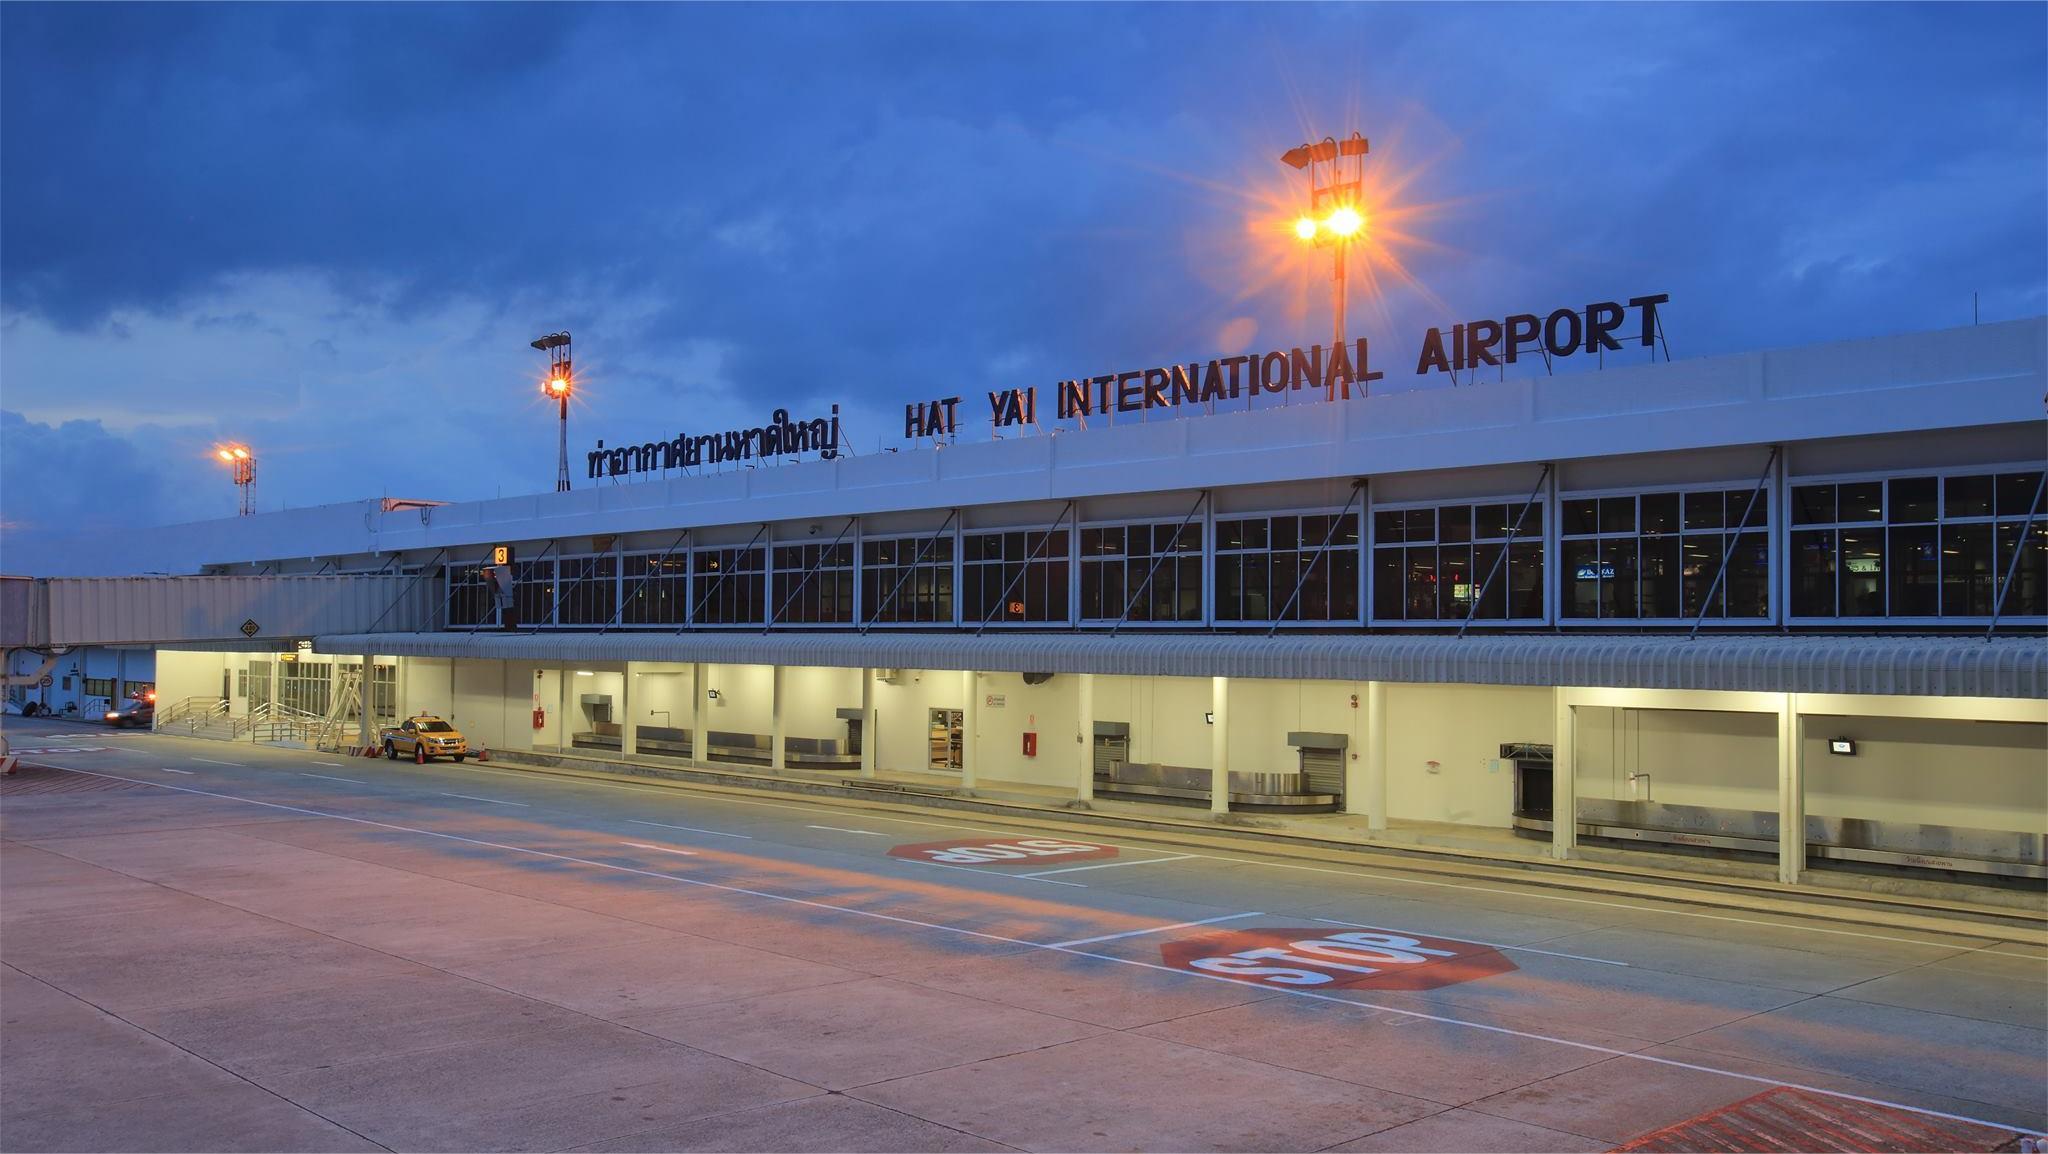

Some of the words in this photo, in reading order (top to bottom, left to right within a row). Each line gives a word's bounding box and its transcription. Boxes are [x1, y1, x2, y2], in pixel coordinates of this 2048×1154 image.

[905, 396, 960, 438] HAT
[988, 386, 1036, 426] YAI
[1058, 337, 1384, 419] INTERNATIONAL
[1416, 294, 1669, 375] AIRPORT
[588, 404, 838, 478] ท่าอากาศยานหาดใหญ่
[498, 549, 504, 562] 3
[923, 840, 1101, 863] STOP
[1189, 932, 1457, 984] STOP
